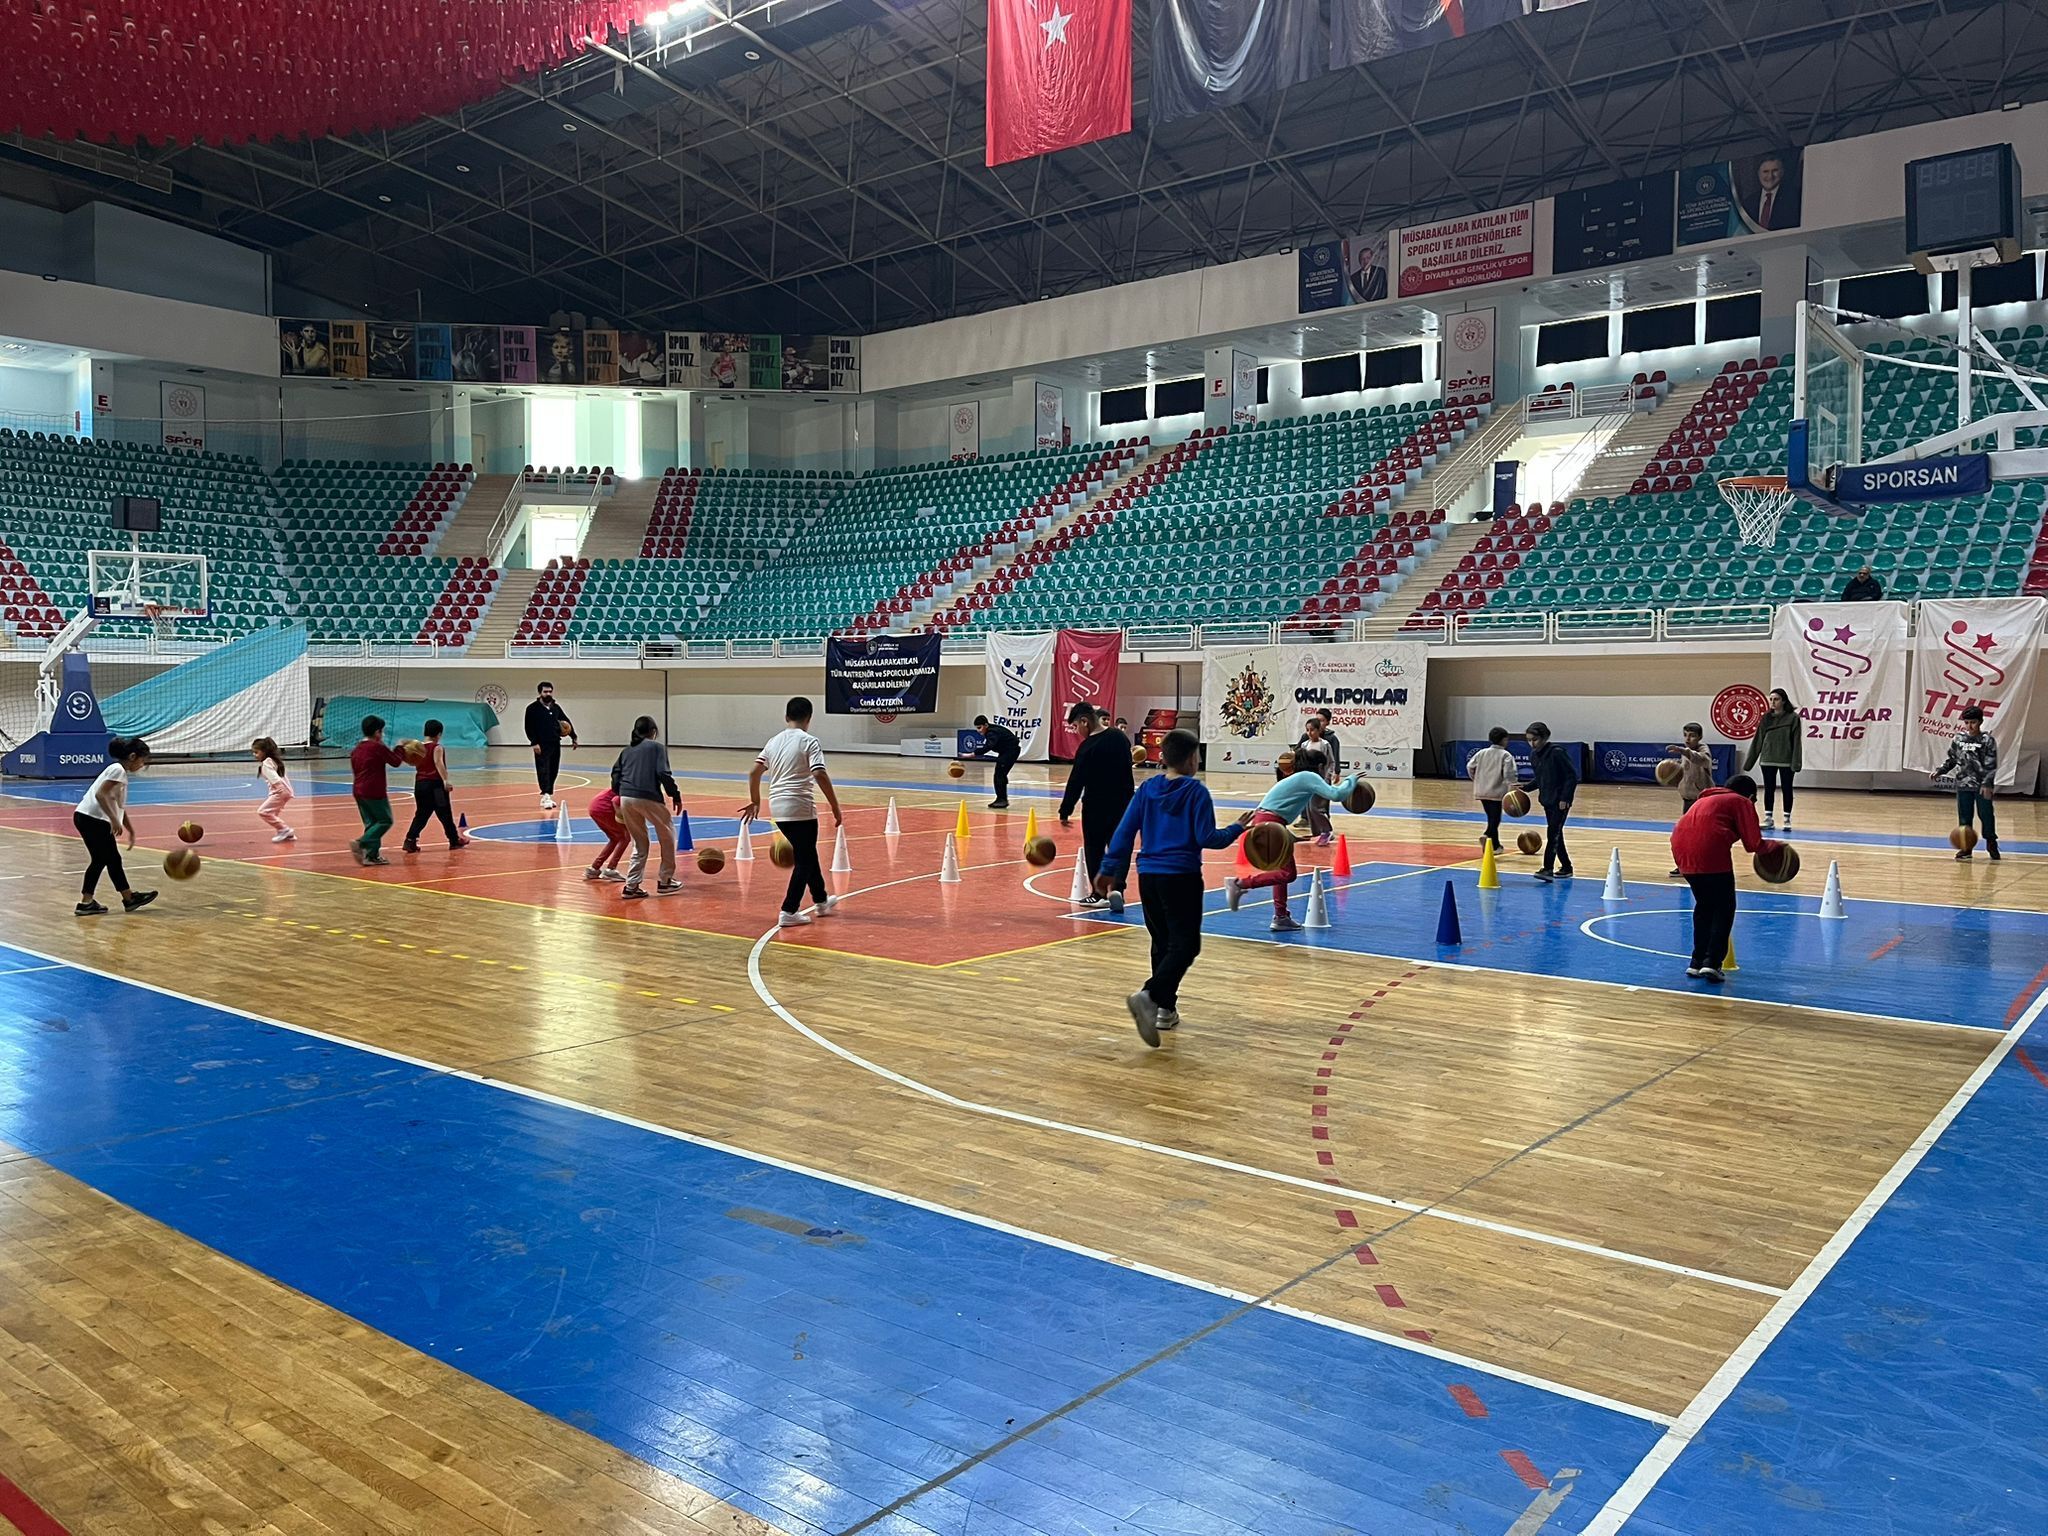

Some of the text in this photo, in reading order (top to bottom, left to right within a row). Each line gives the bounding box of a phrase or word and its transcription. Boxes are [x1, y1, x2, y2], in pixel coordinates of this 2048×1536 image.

[1402, 209, 1529, 244] MÜSABAKALARA KATILAN TÜM
[1407, 225, 1522, 257] SPORCU VE ANTRENÖRLERE
[1421, 243, 1505, 269] BAŞARILAR DİLERİZ.
[1425, 268, 1467, 280] DİYARBAKIR
[1506, 256, 1528, 266] SPOR
[1214, 380, 1223, 392] F
[1447, 376, 1490, 390] SPOR
[98, 394, 108, 407] E
[165, 435, 203, 447] SPOR
[1863, 465, 1958, 490] SPORSAN
[886, 680, 911, 688] DİLERİM
[876, 697, 904, 707] ÖZTEKİN
[1294, 687, 1408, 705] OKUL SPORLARI
[1817, 691, 1858, 704] THF
[1007, 707, 1027, 717] THF
[1300, 707, 1318, 715] HEM
[1349, 708, 1367, 716] HEM
[1799, 707, 1892, 721] ADINLAR
[993, 715, 1042, 729] ERKEKLER
[1331, 717, 1366, 727] BAŞARI
[1918, 716, 1952, 729] Türkiye
[1015, 728, 1031, 740] LİG
[1806, 722, 1865, 739] 2. LİG
[59, 754, 104, 764] SPORSAN
